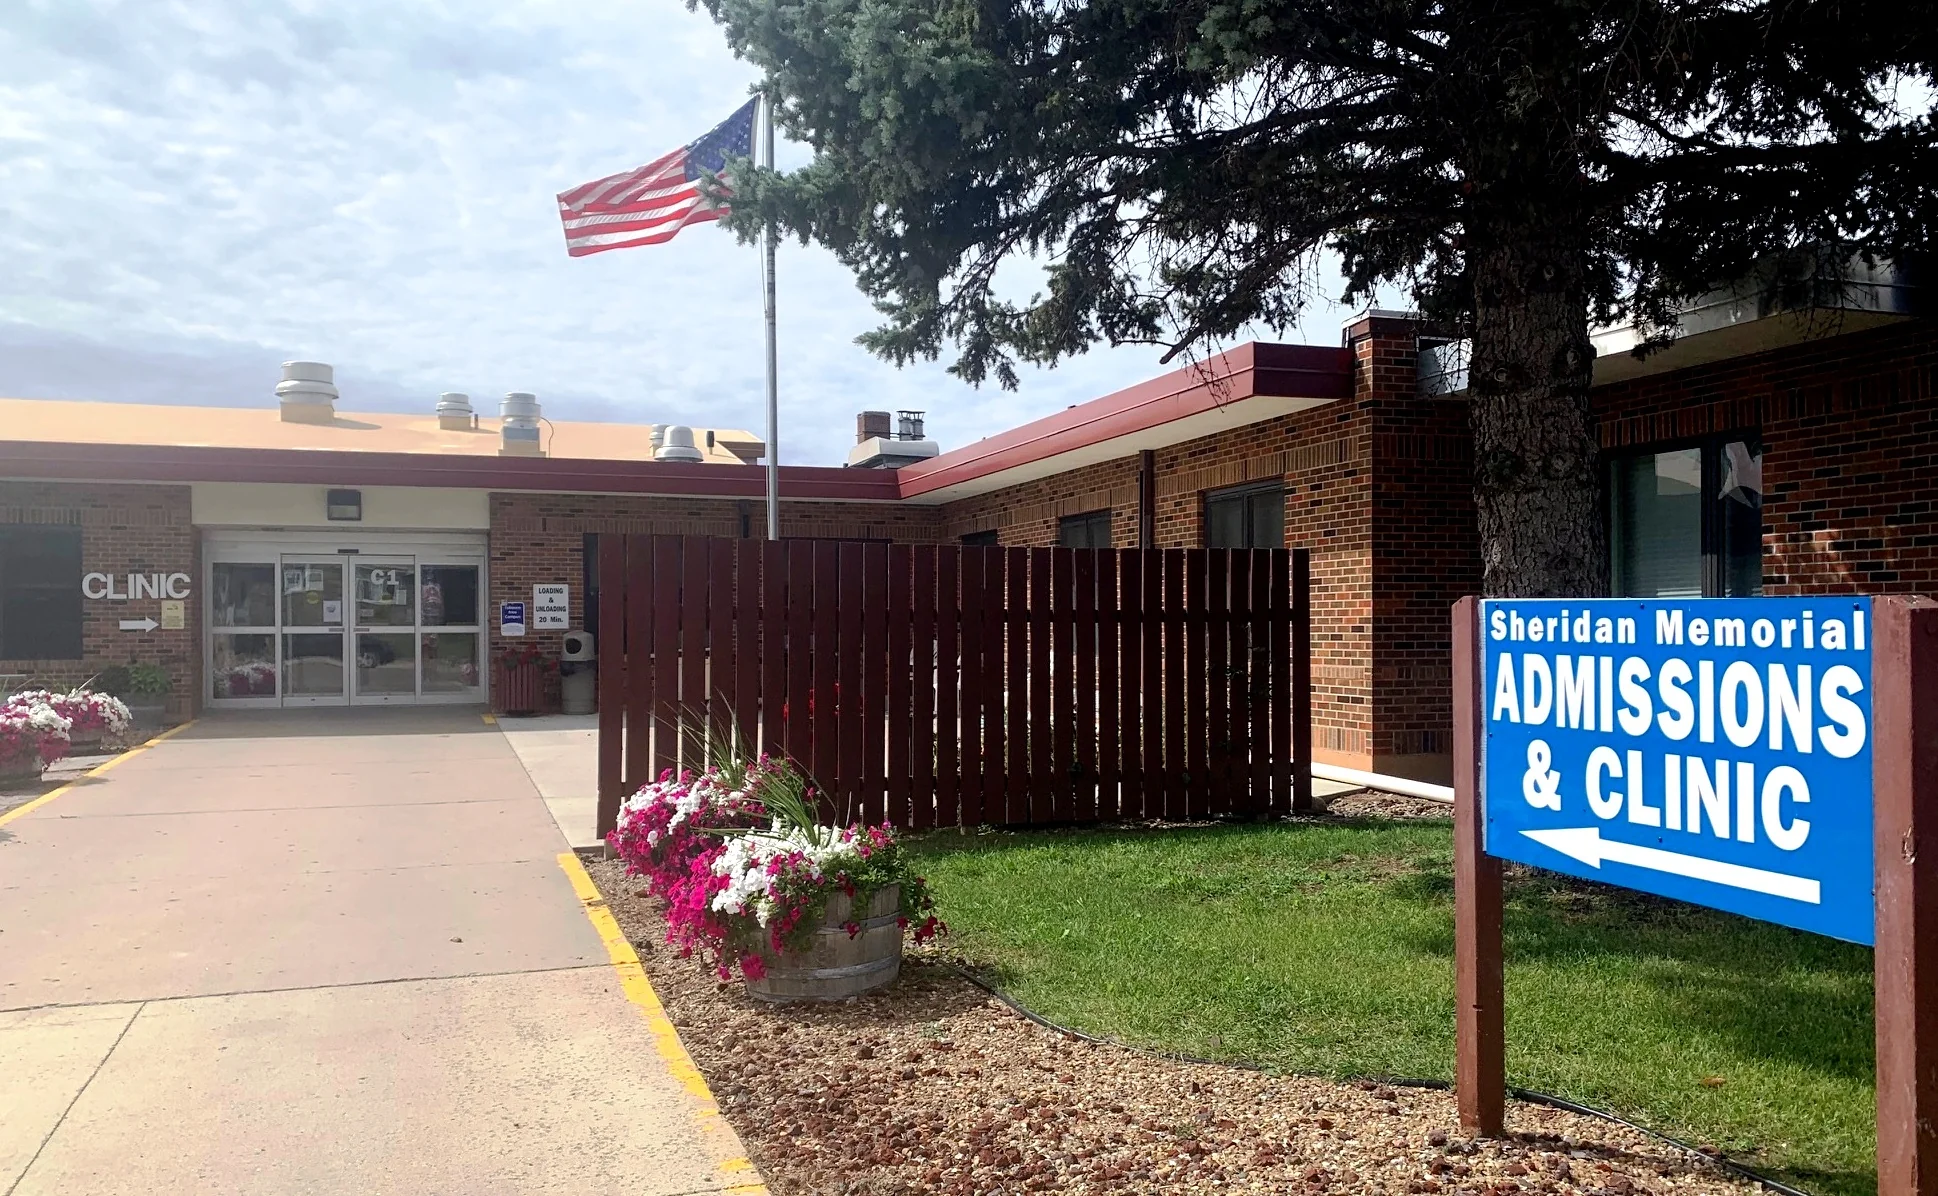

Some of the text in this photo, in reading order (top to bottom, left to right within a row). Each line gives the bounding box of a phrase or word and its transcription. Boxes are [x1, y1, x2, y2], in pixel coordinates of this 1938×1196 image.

[81, 572, 191, 599] CLINIC
[370, 569, 399, 585] C1
[550, 615, 564, 623] Min.
[1490, 608, 1866, 650] Sheridan Memorial
[1492, 652, 1866, 759] ADMISSIONS
[1522, 739, 1811, 851] & CLINIC
